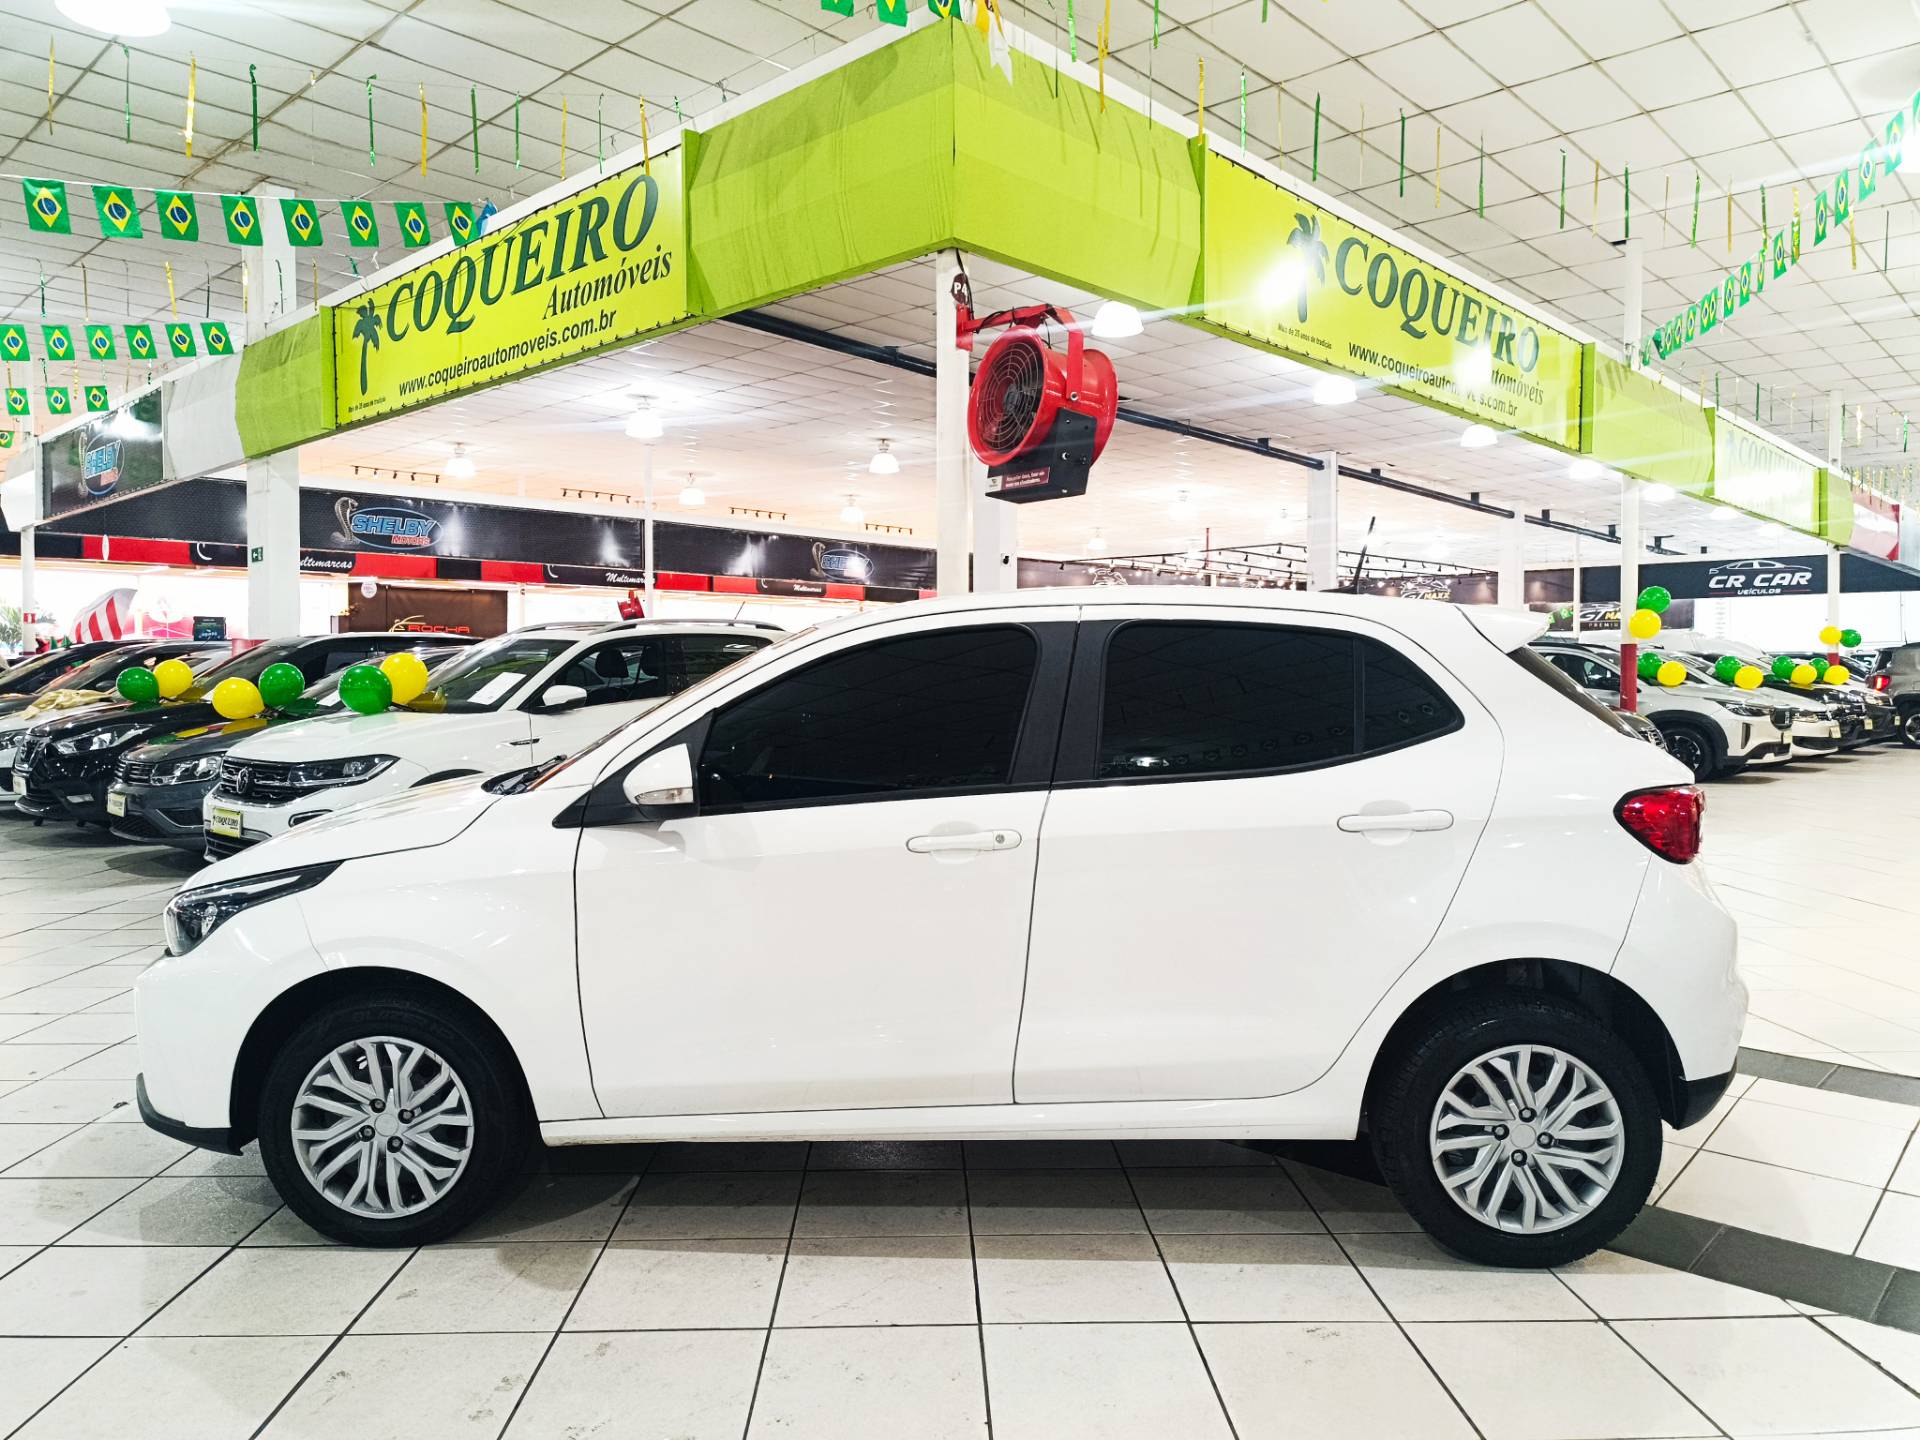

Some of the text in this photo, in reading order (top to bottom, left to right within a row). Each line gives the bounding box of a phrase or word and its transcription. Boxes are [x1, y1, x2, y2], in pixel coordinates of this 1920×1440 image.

[386, 173, 659, 342] COQUEIRO
[542, 244, 673, 320] Automóveis
[1335, 236, 1540, 373] COQUEIRO
[399, 309, 617, 396] www.coqueiroautomoveis.com.br
[351, 514, 437, 536] SHELBY
[1708, 571, 1812, 589] CR CAR
[407, 624, 472, 634] ROCHA
